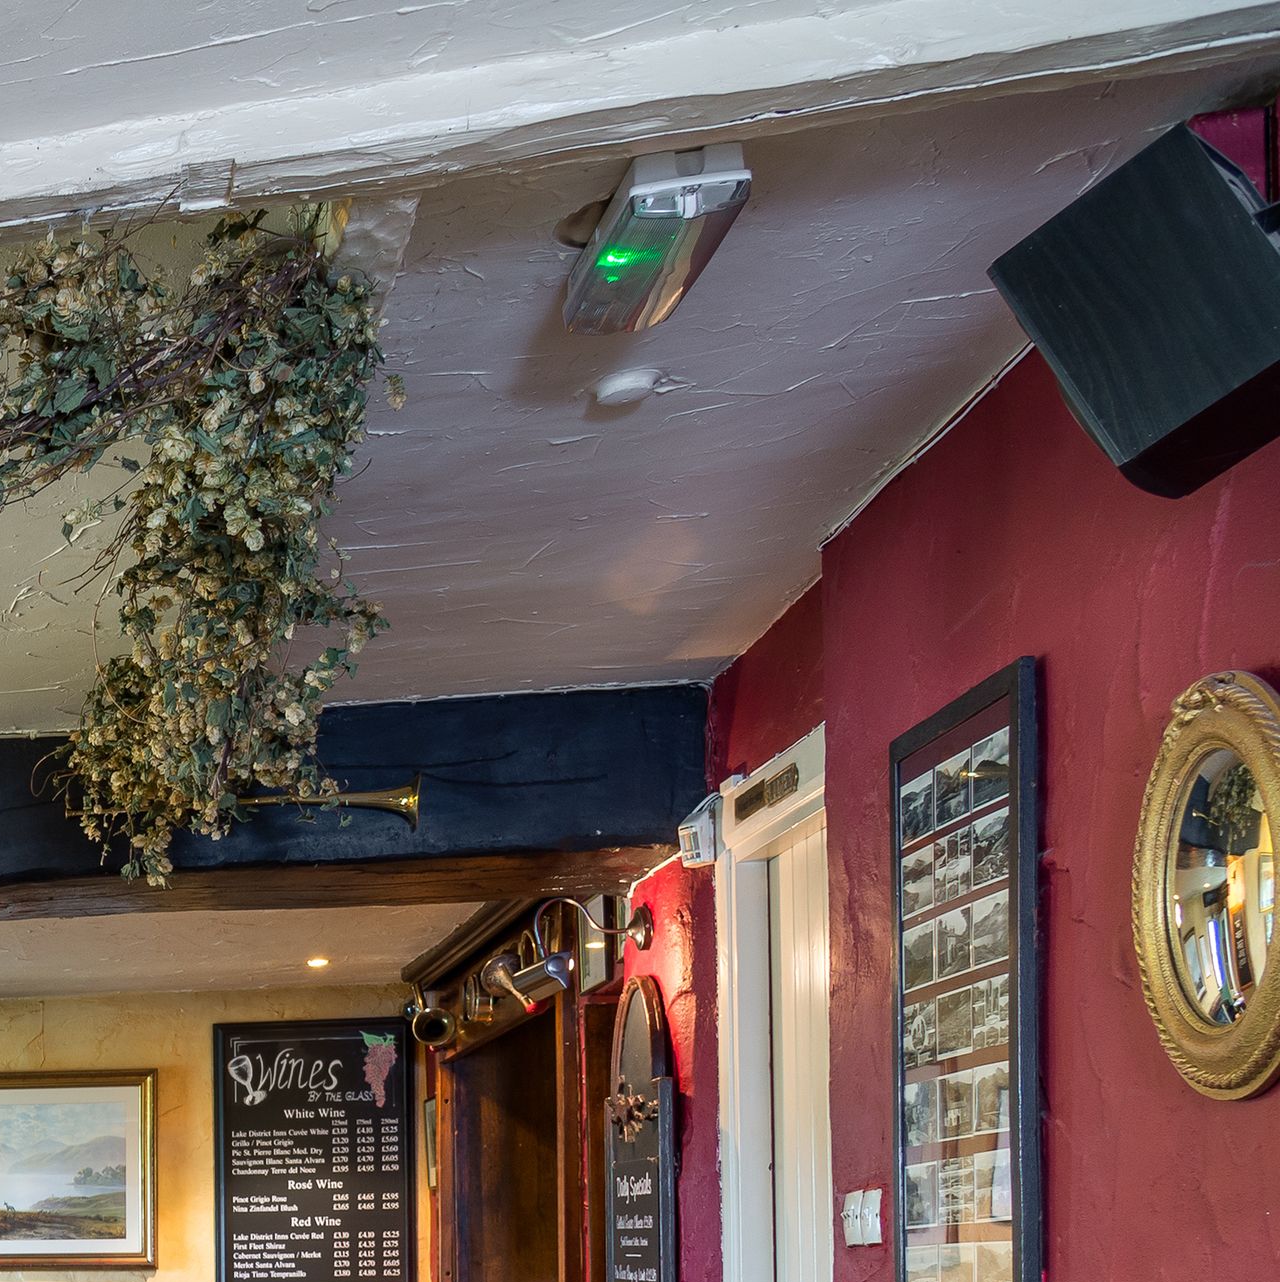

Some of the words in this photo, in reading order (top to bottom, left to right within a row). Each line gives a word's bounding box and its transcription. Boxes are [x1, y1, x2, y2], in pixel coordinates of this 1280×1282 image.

[256, 1048, 343, 1091] Wines
[308, 1091, 320, 1102] BY
[325, 1092, 342, 1101] THE
[345, 1091, 374, 1101] GLASS
[284, 1109, 315, 1118] White
[319, 1108, 345, 1118] Wine
[274, 1139, 293, 1147] Grigio
[288, 1180, 312, 1190] Rosé
[316, 1179, 343, 1189] Wine
[616, 1175, 629, 1204] Daily
[630, 1172, 652, 1202] Specials
[250, 1196, 270, 1204] Grigio
[281, 1204, 298, 1212] Blush
[291, 1217, 311, 1226] Red
[315, 1216, 341, 1226] Wine
[263, 1252, 295, 1260] Sauvignon
[234, 1271, 250, 1279] Rioja
[270, 1270, 306, 1278] Tempranillo
